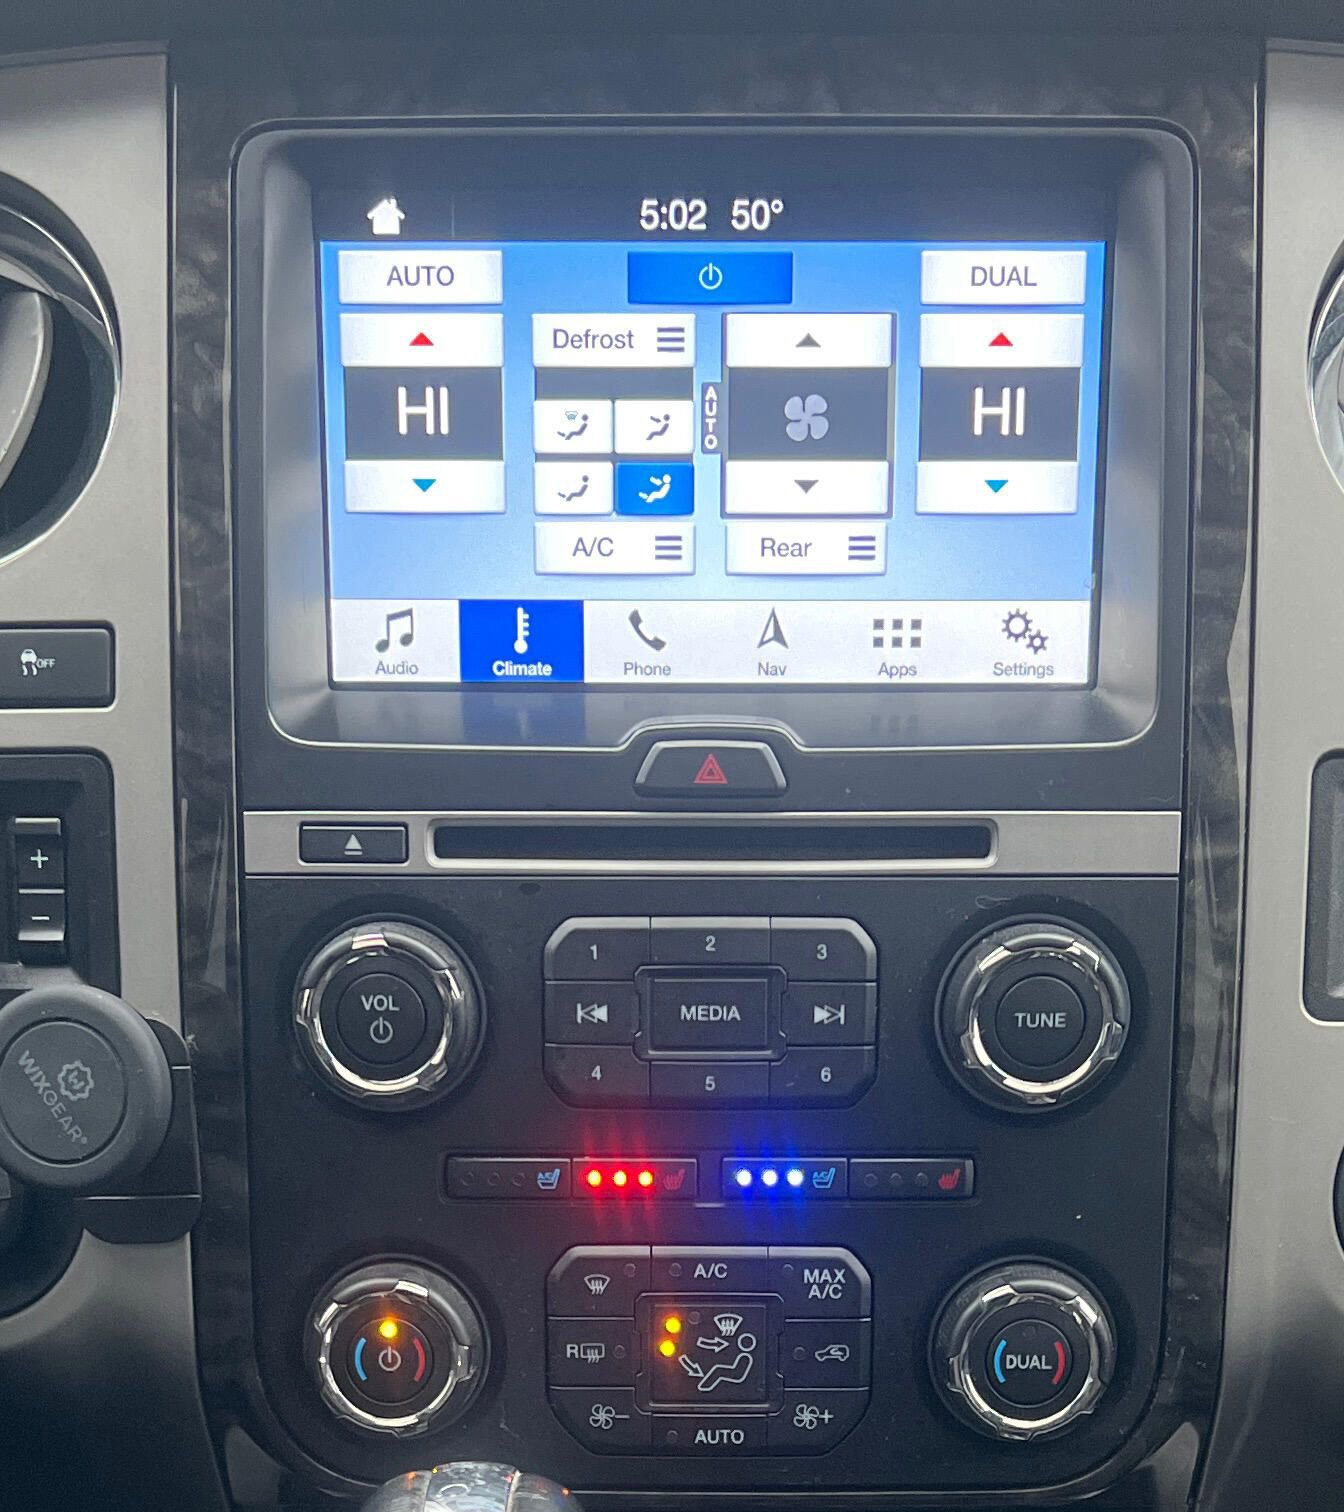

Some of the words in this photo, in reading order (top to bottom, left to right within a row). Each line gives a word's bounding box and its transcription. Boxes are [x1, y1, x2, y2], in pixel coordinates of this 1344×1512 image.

[640, 199, 706, 230] 5:02
[387, 266, 454, 286] AUTO
[971, 266, 1037, 286] DUAL
[553, 329, 634, 349] Defrost
[398, 387, 448, 434] HI
[705, 386, 717, 449] AUTO
[974, 388, 1025, 435] HI
[573, 537, 613, 557] A/C
[761, 538, 812, 557] Rear
[36, 658, 56, 669] OFF
[375, 661, 419, 676] Audio
[493, 661, 552, 676] Climate
[623, 661, 672, 677] Phone
[757, 662, 787, 677] Nav
[878, 662, 917, 680] Apps
[993, 662, 1054, 681] Settings
[706, 936, 715, 951] 2
[590, 945, 597, 959] 1
[817, 944, 827, 959] 3
[361, 995, 399, 1010] VOL
[681, 1005, 740, 1020] MEDIA
[1015, 1013, 1066, 1027] TUNE
[592, 1066, 601, 1080] 4
[821, 1067, 831, 1082] 6
[706, 1076, 715, 1091] 5
[694, 1264, 727, 1278] A/C
[804, 1269, 845, 1283] MAX
[808, 1285, 842, 1300] A/C
[567, 1344, 578, 1358] R
[1006, 1355, 1052, 1369] DUAL
[695, 1430, 744, 1444] AUTO
